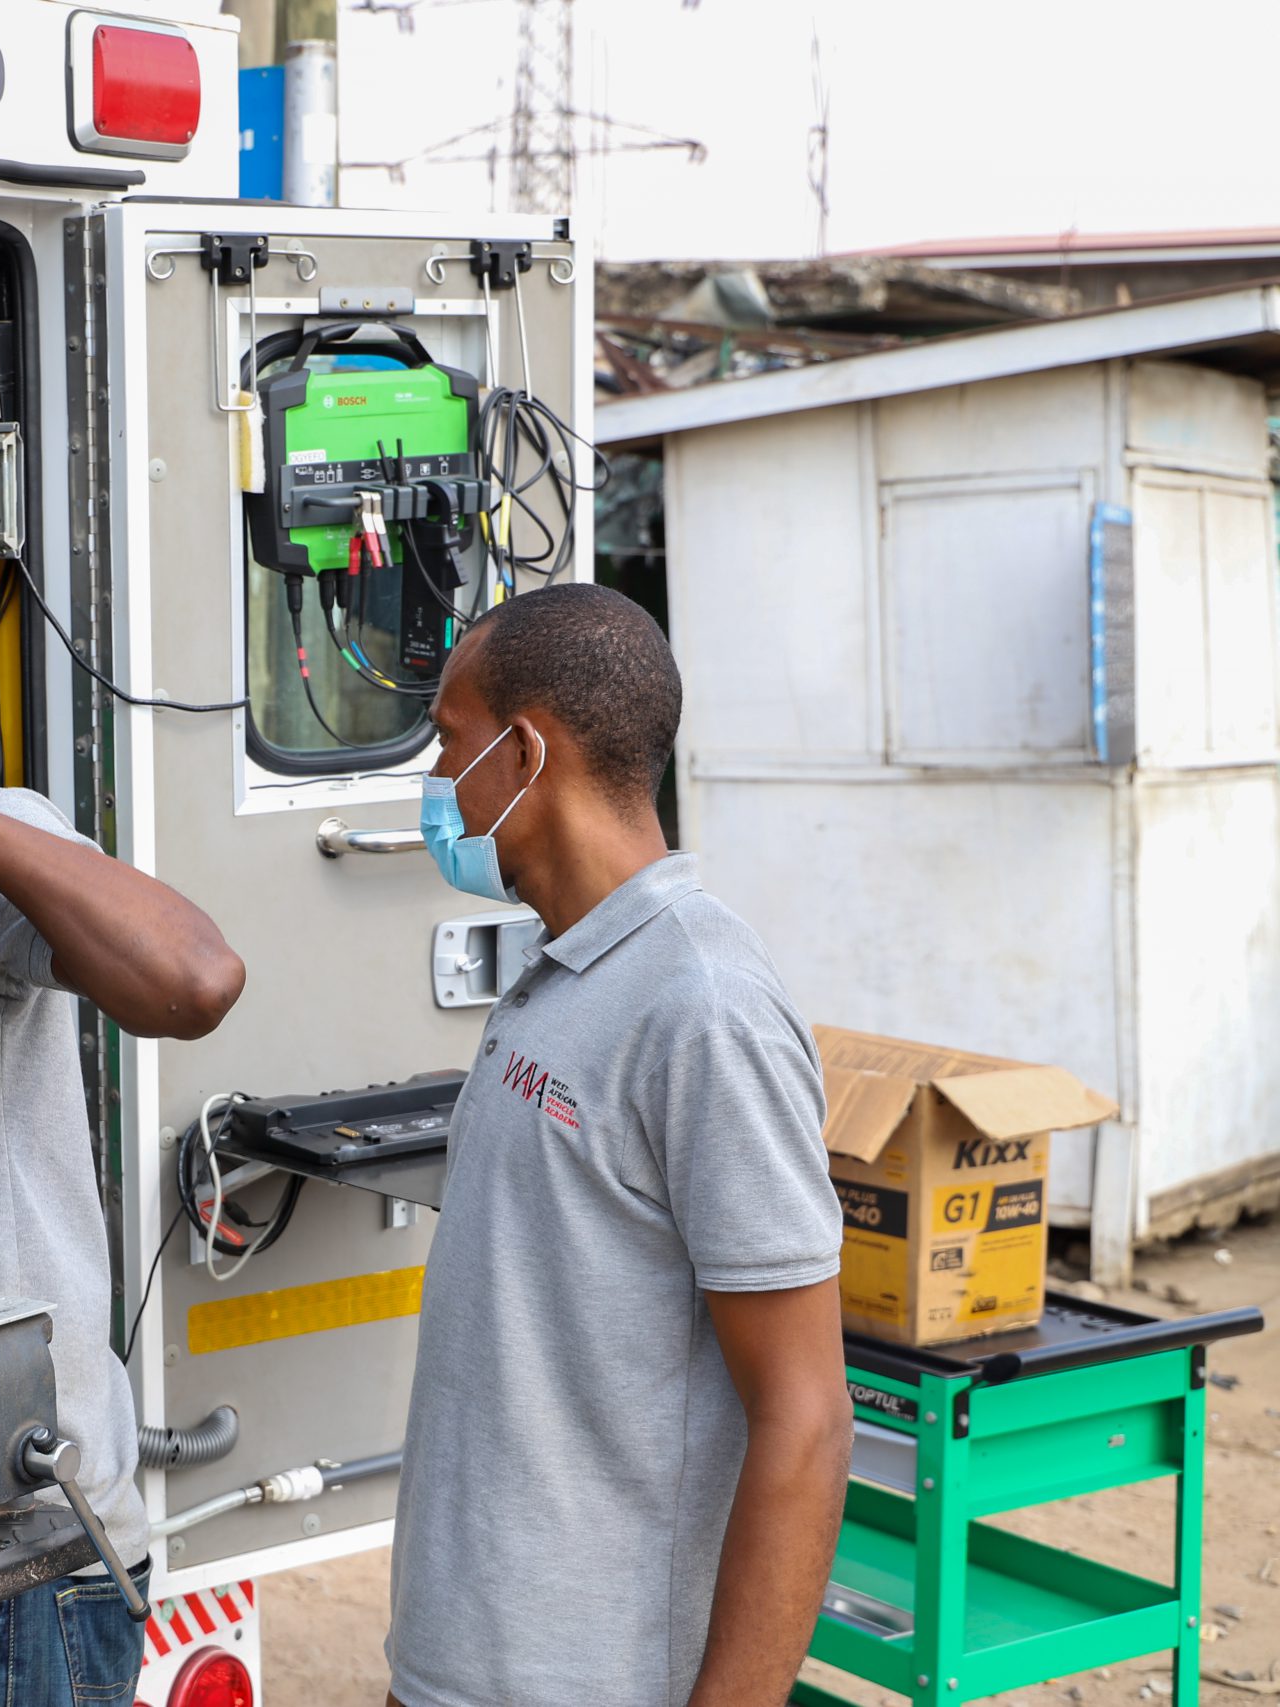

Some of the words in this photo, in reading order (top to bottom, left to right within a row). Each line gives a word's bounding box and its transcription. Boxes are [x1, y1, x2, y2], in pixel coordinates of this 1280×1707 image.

[337, 397, 367, 406] BOSCH
[550, 1077, 569, 1093] WEST
[546, 1096, 574, 1116] VEHICLE
[548, 1088, 578, 1108] AFRICAN
[544, 1106, 581, 1129] ACADEMY
[848, 1188, 878, 1204] PLUS
[944, 1190, 980, 1223] G1
[995, 1200, 1040, 1220] 10W-40
[848, 1382, 900, 1411] TOPTUL
